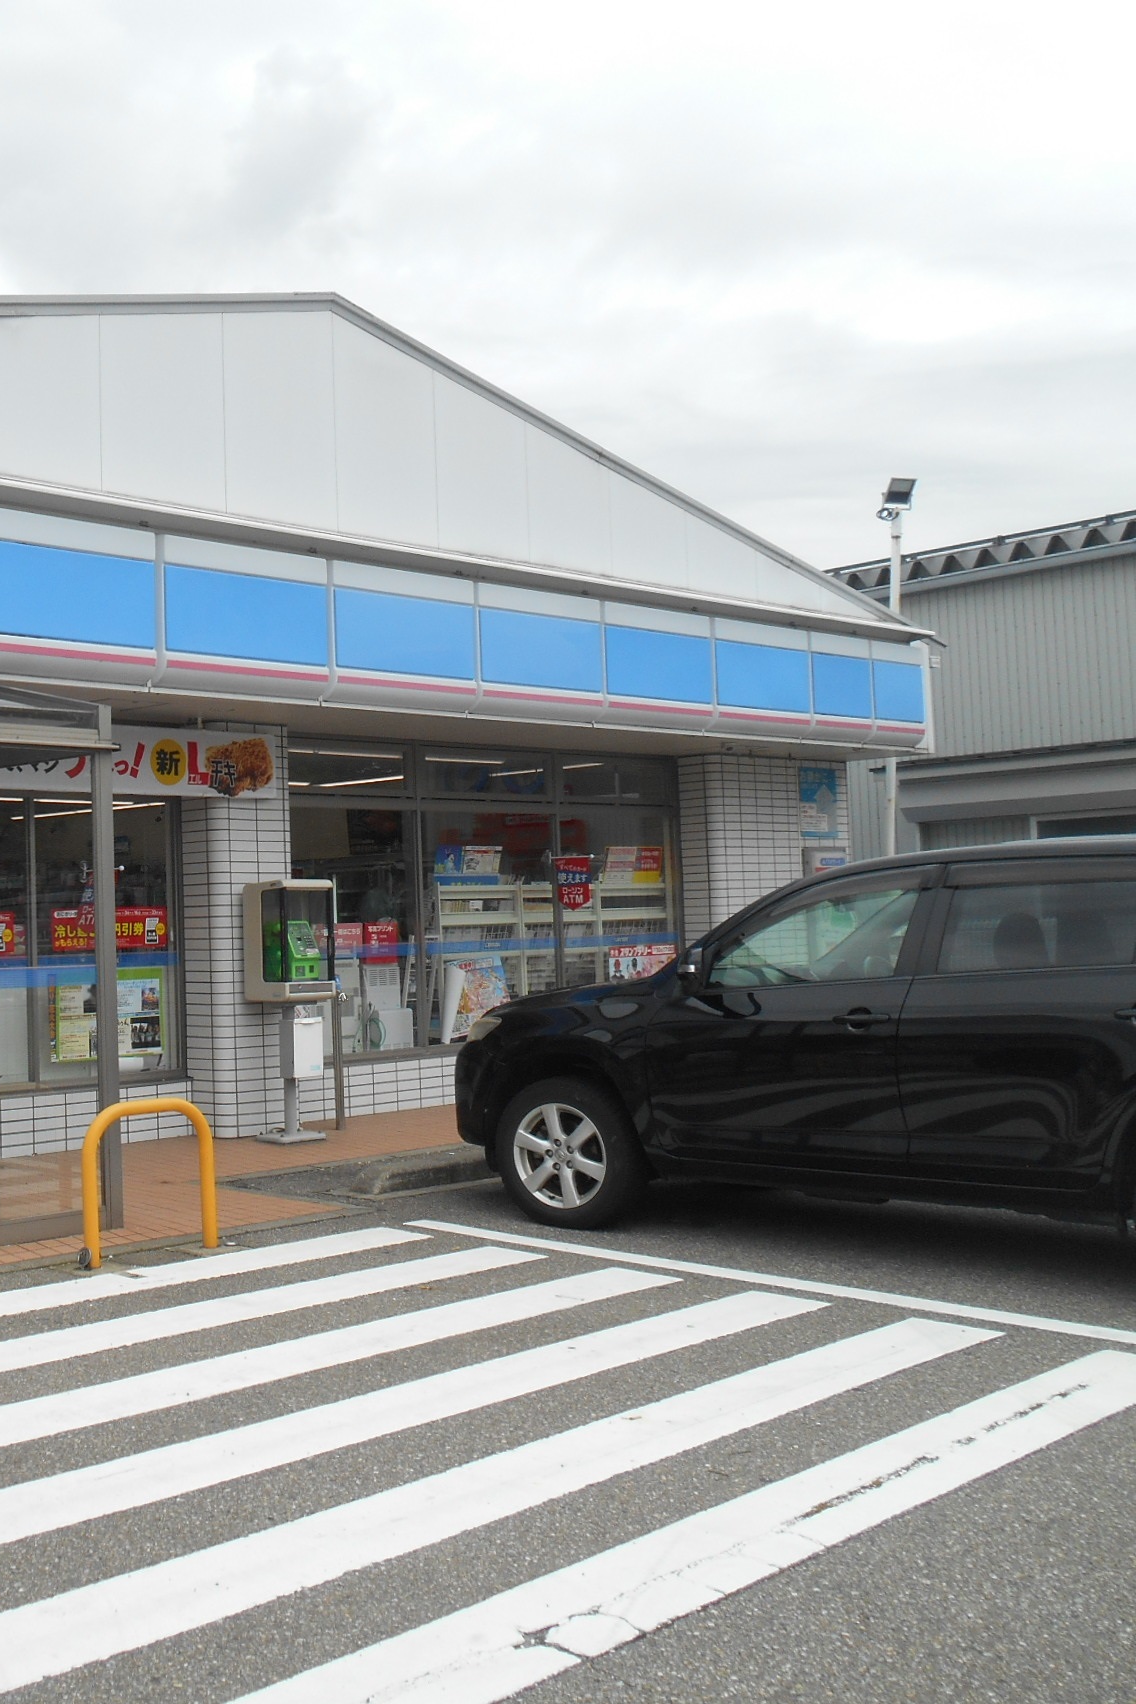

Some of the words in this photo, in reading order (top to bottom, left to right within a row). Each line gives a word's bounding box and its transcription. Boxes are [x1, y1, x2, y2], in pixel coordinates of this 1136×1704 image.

[156, 748, 180, 777] 新
[558, 872, 588, 884] 使えます
[562, 887, 584, 895] ローソン
[563, 894, 584, 904] ATM
